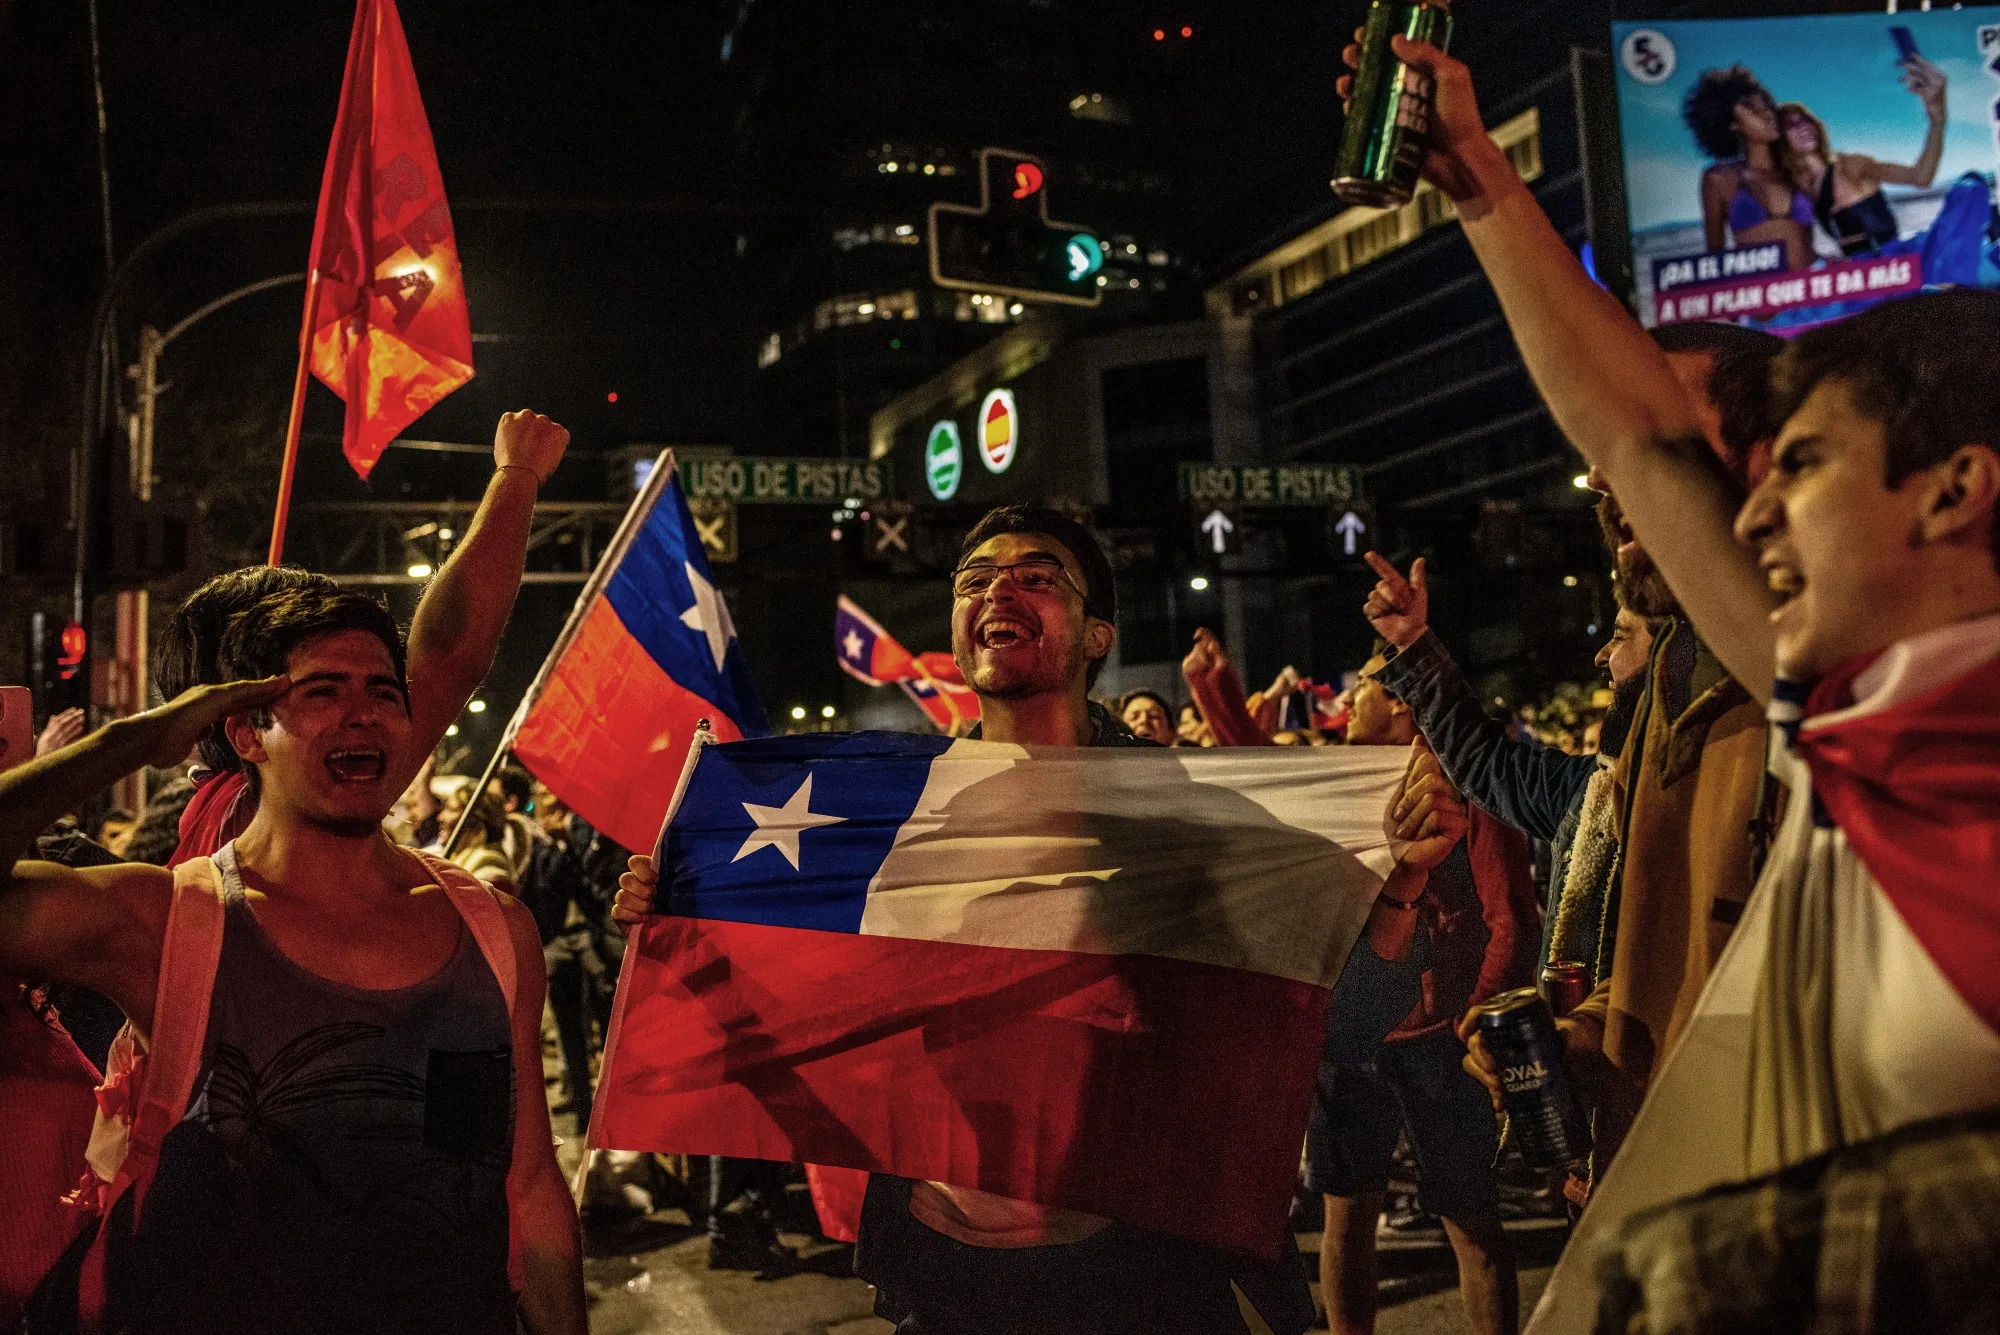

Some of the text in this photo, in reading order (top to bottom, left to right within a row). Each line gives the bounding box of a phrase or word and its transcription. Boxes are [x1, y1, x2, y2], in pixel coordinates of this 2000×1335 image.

[1698, 255, 1719, 280] EL
[1723, 245, 1781, 277] PASO!
[1660, 258, 1912, 322] A UN PLAN QUE TE DA MÁS
[689, 463, 881, 497] USO DE PISTAS
[1189, 467, 1351, 499] USO DE PISTAS
[1502, 1060, 1548, 1083] OYAL
